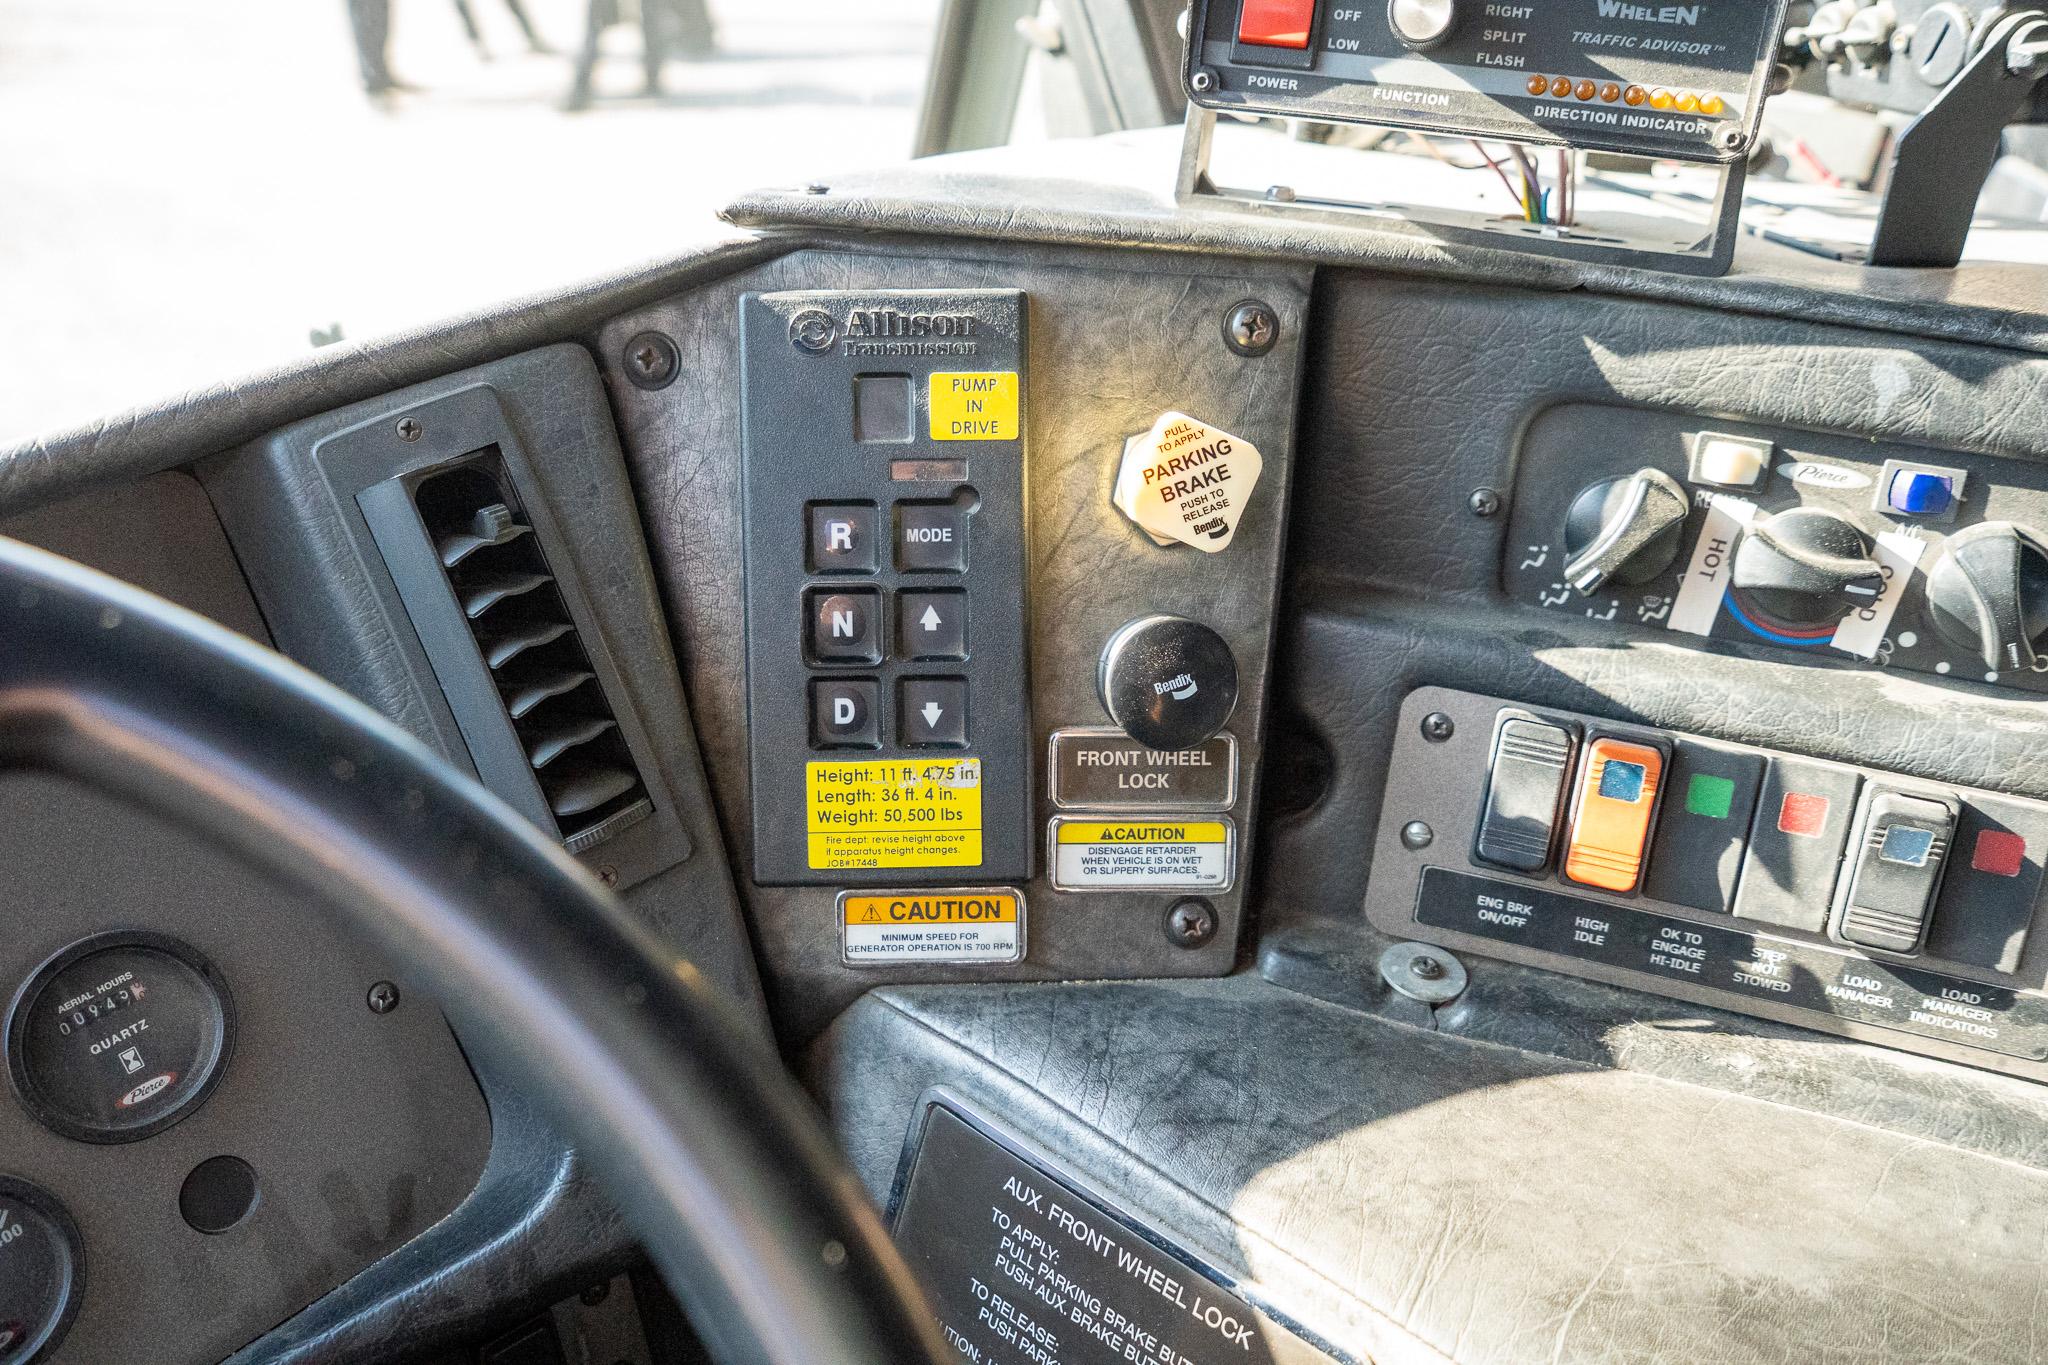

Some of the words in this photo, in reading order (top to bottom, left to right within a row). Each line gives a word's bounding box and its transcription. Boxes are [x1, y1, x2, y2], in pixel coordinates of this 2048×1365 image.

[1333, 9, 1362, 22] OFF
[1485, 4, 1533, 20] RIGHT
[1597, 0, 1700, 26] WHELEN
[1327, 38, 1360, 51] LOW
[1483, 30, 1527, 44] SPLIT
[1572, 31, 1637, 49] TRAFFIC
[1476, 52, 1525, 68] FLASH
[1247, 75, 1298, 91] POWER
[1373, 87, 1449, 106] FUNCTION
[1533, 104, 1618, 126] DIRECTION
[1621, 114, 1708, 135] INDICATOR
[842, 311, 978, 337] Allison
[842, 340, 977, 356] Transmission
[952, 378, 998, 392] PUMP
[966, 400, 983, 413] IN
[952, 420, 999, 435] DRIVE
[1164, 423, 1192, 439] PULL
[1158, 442, 1173, 453] TO
[1174, 428, 1206, 448] APPLY
[1142, 438, 1232, 485] PARKING
[1160, 463, 1232, 503] BRAKE
[1797, 465, 1849, 484] Pierce
[1180, 494, 1209, 512] PUSH
[1210, 488, 1225, 500] TO
[1183, 498, 1230, 523] RELEASE
[906, 527, 952, 543] MODE
[1193, 515, 1226, 536] Bendix
[831, 523, 852, 550] R
[1699, 537, 1728, 582] HOT
[832, 610, 854, 638] N
[1153, 673, 1193, 696] Bendix
[834, 697, 856, 725] D
[1077, 750, 1141, 766] FRONT
[1146, 751, 1211, 766] WHEEL
[816, 767, 873, 785] Height:
[880, 767, 896, 782] 11
[902, 767, 917, 781] ft.
[922, 766, 955, 781] 4.75
[960, 766, 979, 780] in.
[1118, 773, 1170, 789] LOCK
[817, 789, 876, 806] Length:
[881, 788, 900, 801] 36
[905, 788, 919, 801] ft.
[924, 788, 934, 801] 4
[939, 787, 957, 800] in.
[817, 809, 878, 826] Weight:
[883, 808, 936, 823] 50,500
[940, 807, 963, 821] lbs
[826, 836, 842, 845] Fire
[872, 835, 900, 844] revise
[902, 834, 932, 846] height
[935, 834, 966, 843] above
[1115, 827, 1186, 840] CAUTION
[826, 848, 831, 856] if
[834, 848, 882, 857] apparatus
[884, 847, 915, 857] height
[917, 846, 961, 856] changes.
[1088, 846, 1144, 855] DISENGAGE
[1146, 846, 1197, 855] RETARDER
[826, 859, 878, 868] JOB#17448
[1081, 856, 1110, 865] WHEN
[1113, 856, 1152, 865] VEHICLE
[1154, 856, 1164, 865] IS
[1165, 856, 1180, 865] ON
[1182, 856, 1203, 864] WET
[1083, 866, 1097, 875] OR
[1099, 866, 1146, 875] SLIPPERY
[889, 900, 1001, 920] CAUTION
[1477, 894, 1504, 910] ENG
[1506, 900, 1534, 916] BRK
[1478, 909, 1527, 929] ON/OFF
[1575, 916, 1610, 932] HIGH
[881, 933, 923, 942] MINIMUM
[926, 932, 957, 941] SPEED
[959, 932, 979, 940] FOR
[1574, 930, 1605, 946] IDLE
[1661, 927, 1682, 941] OK
[1684, 931, 1703, 945] TO
[847, 944, 905, 953] GENERATOR
[907, 943, 962, 952] OPERATION
[964, 943, 973, 951] IS
[975, 943, 991, 951] 700
[993, 942, 1014, 950] RPM
[1651, 939, 1706, 961] ENGAGE
[1751, 946, 1787, 963] STEP
[1650, 953, 1702, 974] HI-IDLE
[1751, 961, 1781, 977] NOT
[1732, 971, 1792, 993] STOWED
[1842, 974, 1882, 992] LOAD
[57, 991, 95, 1014] AERIAL
[96, 971, 133, 994] HOURS
[1824, 984, 1894, 1010] MANAGER
[1941, 987, 1981, 1005] LOAD
[1921, 998, 1994, 1024] MANAGER
[1909, 1009, 1999, 1040] INDICATORS
[90, 1018, 149, 1055] QUARTZ
[130, 1077, 165, 1103] Pierce
[991, 1206, 1011, 1231] TO
[1012, 1223, 1060, 1265] APPLY:
[1003, 1175, 1044, 1215] AUX.
[1047, 1203, 1116, 1259] FRONT
[1118, 1247, 1187, 1310] WHEEL
[1191, 1296, 1255, 1350] LOCK
[995, 1254, 1035, 1291] PUSH
[1034, 1284, 1067, 1316] AUX.
[1070, 1307, 1123, 1352] BRAKE
[1000, 1236, 1036, 1272] PULL
[1037, 1261, 1101, 1316] PARKING
[1103, 1307, 1158, 1353] BRAKE
[969, 1277, 989, 1300] TO
[990, 1293, 1060, 1353] RELEASE:
[978, 1306, 1018, 1344] PUSH
[1018, 1337, 1063, 1365] PARK
